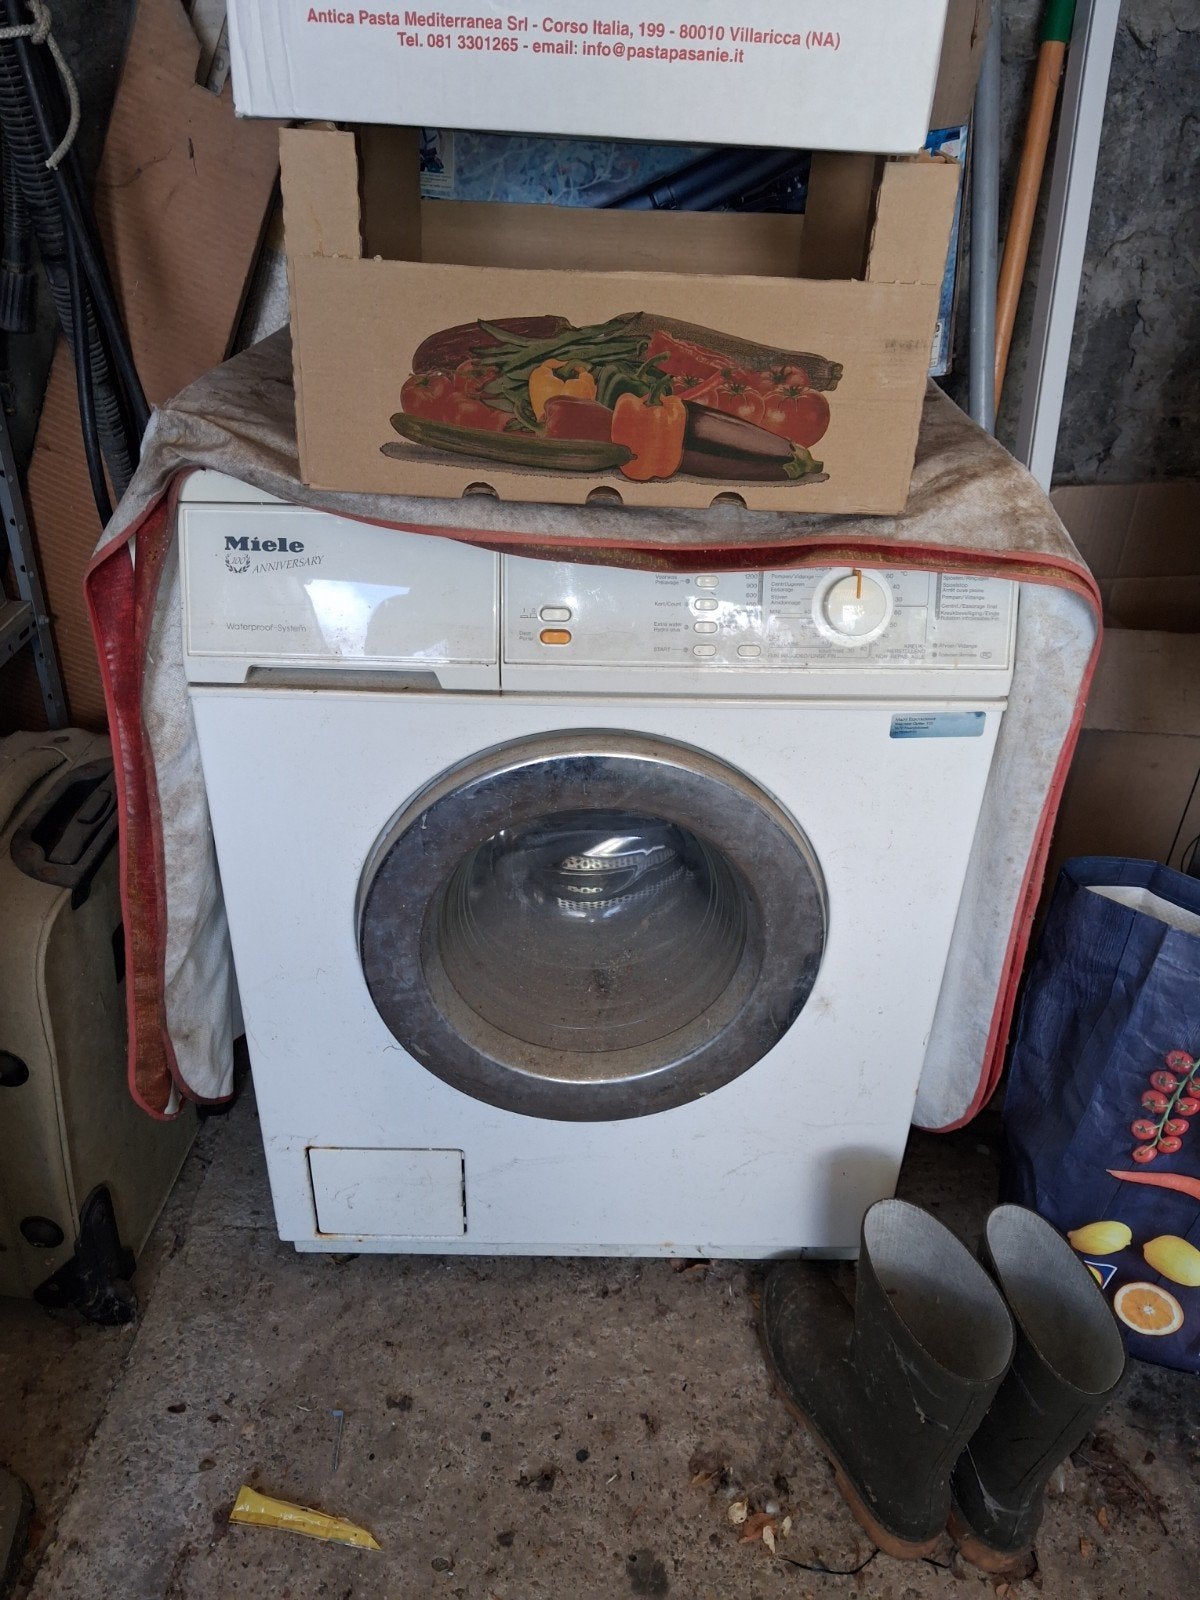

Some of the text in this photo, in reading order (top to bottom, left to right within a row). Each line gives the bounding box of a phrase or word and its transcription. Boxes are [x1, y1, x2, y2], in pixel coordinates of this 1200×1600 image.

[307, 8, 355, 24] Antica
[358, 10, 400, 26] Pasta
[404, 11, 503, 31] Mediterranea
[507, 15, 528, 32] Srl
[542, 17, 589, 35] Corso
[593, 20, 634, 38] Italia,
[638, 22, 665, 38] 199
[680, 24, 725, 41] 80010
[729, 26, 801, 46] Villaricca
[805, 31, 841, 51] (NA)
[397, 31, 423, 48] Tel.
[427, 33, 452, 49] 081
[457, 35, 519, 52] 3301265
[532, 40, 578, 55] email:
[582, 40, 745, 63] info@pastapasanie.it
[224, 536, 305, 553] Miele
[252, 555, 325, 574] ANNIVERSARY
[226, 622, 307, 634] Waterproof-System
